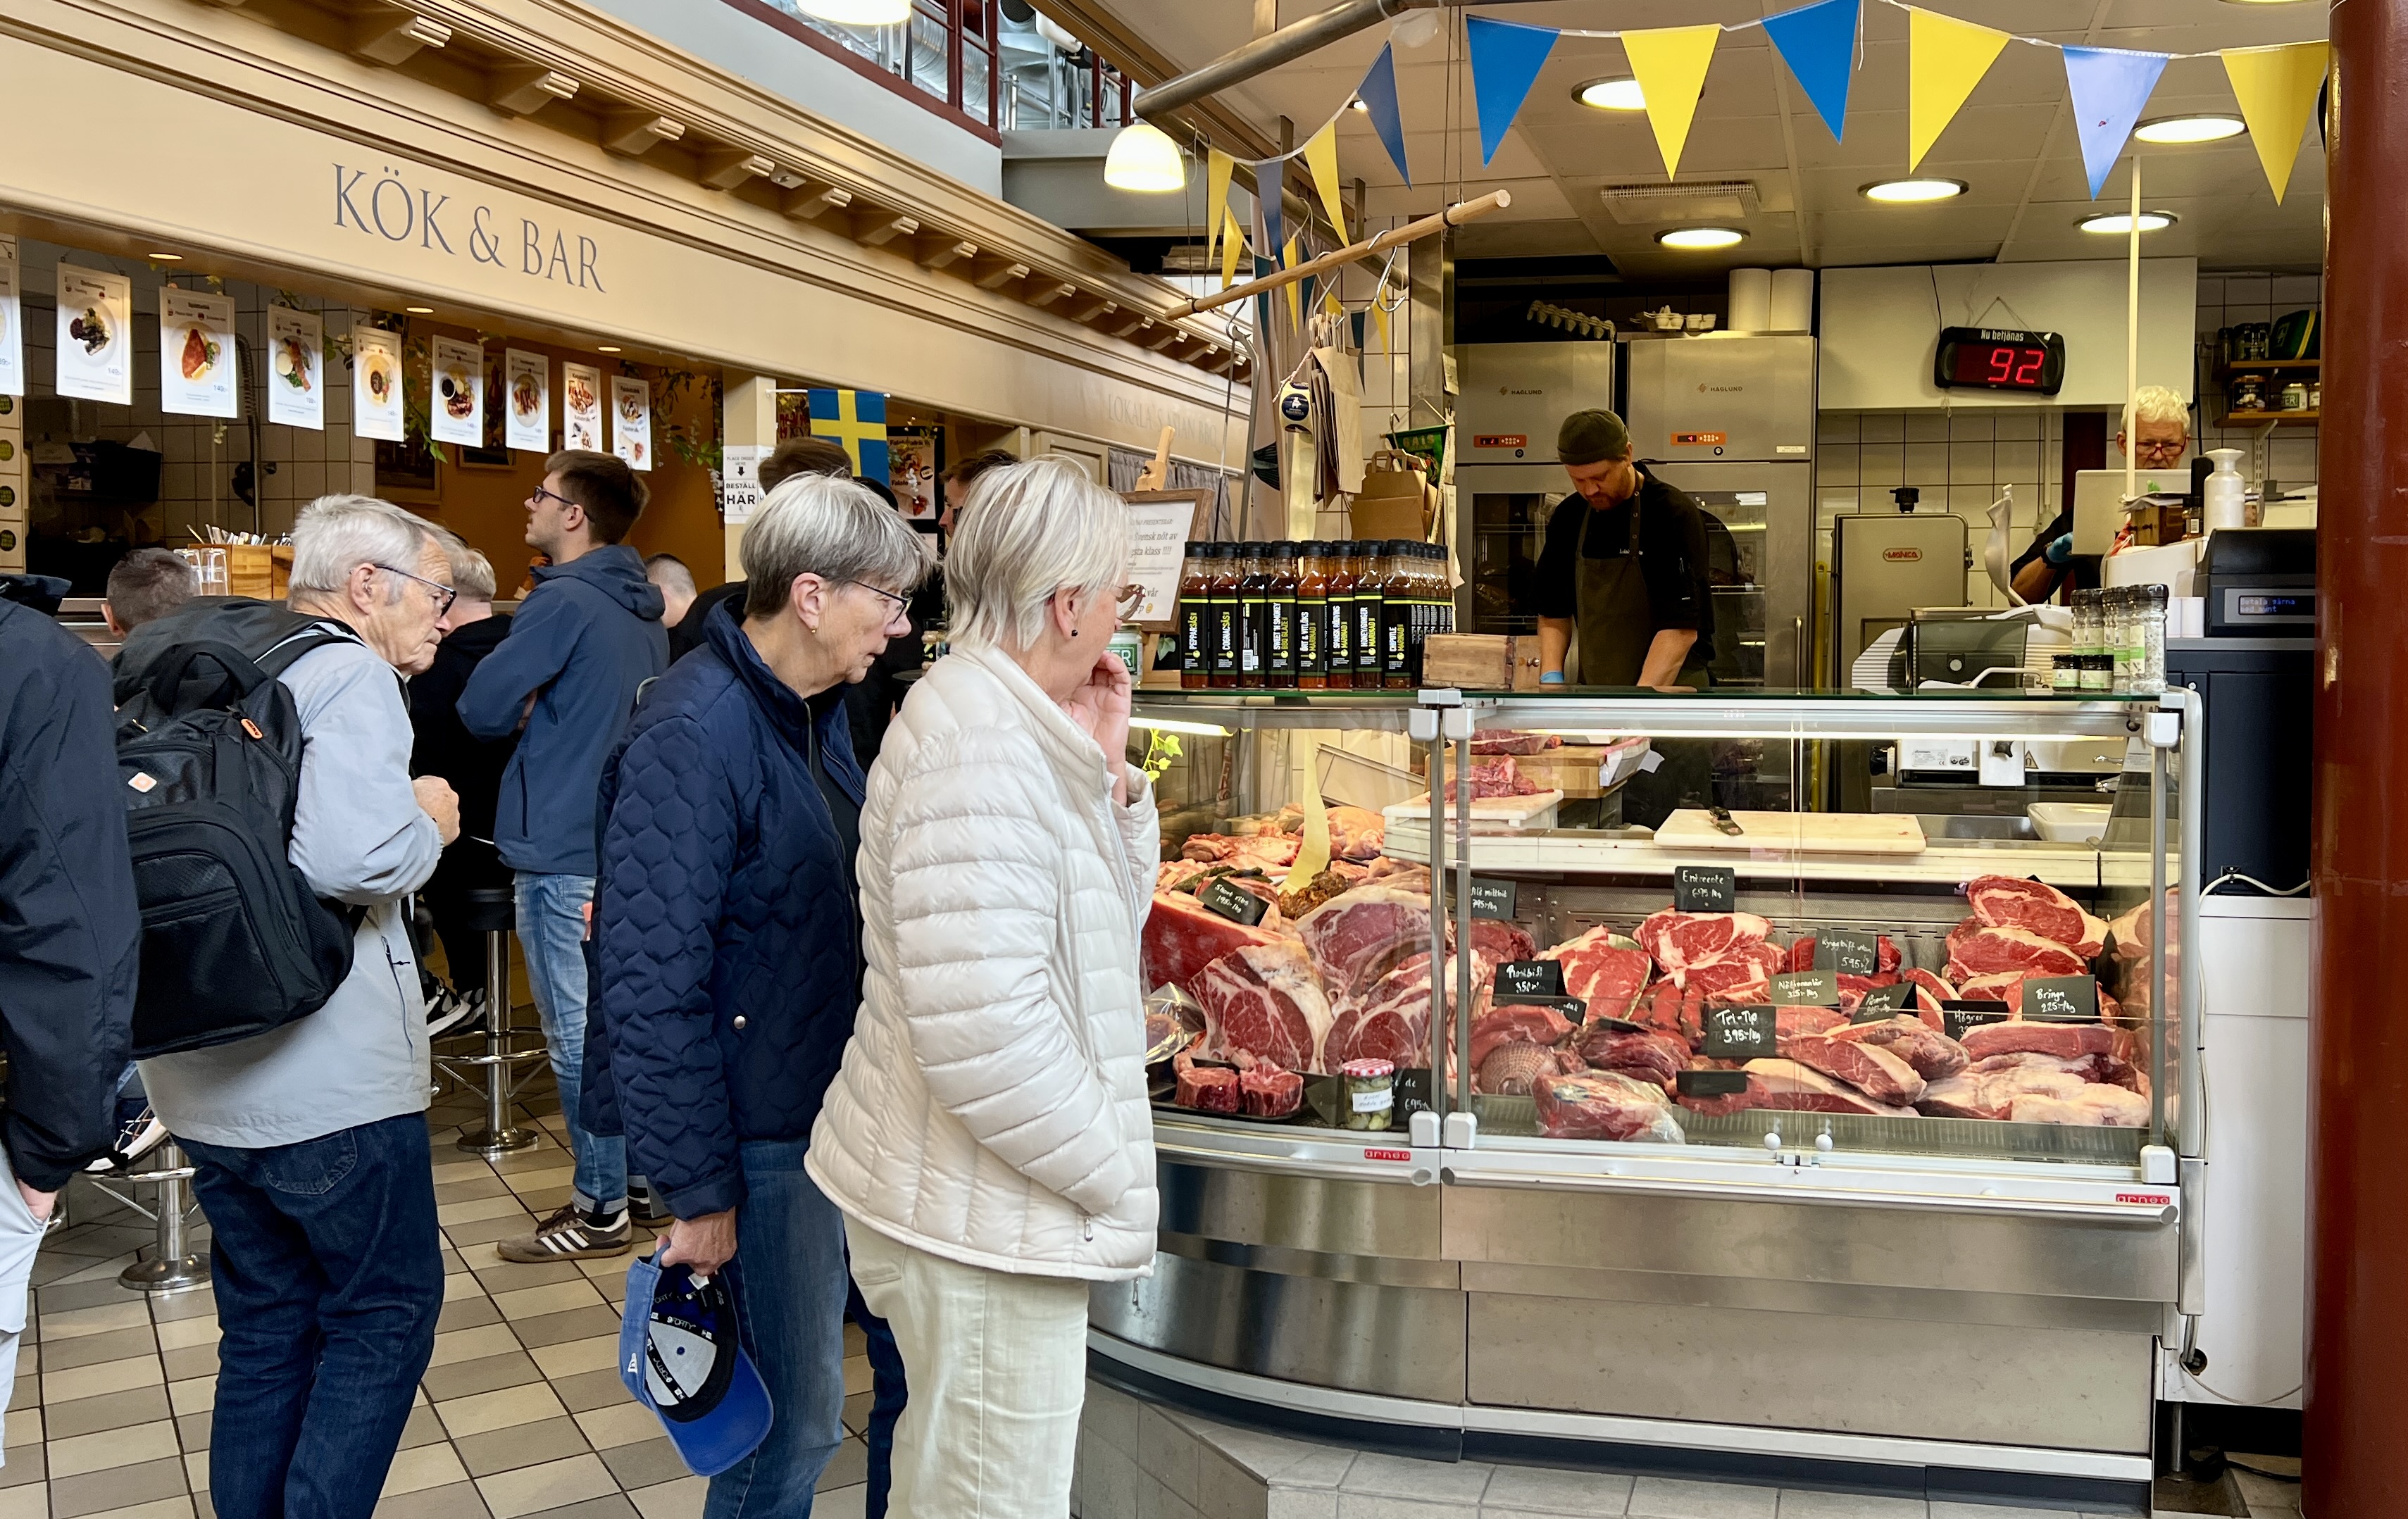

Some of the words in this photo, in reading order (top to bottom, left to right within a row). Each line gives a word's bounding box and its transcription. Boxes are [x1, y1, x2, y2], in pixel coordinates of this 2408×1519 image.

[332, 163, 456, 255] KÖK
[469, 206, 506, 268] &
[520, 218, 606, 293] BAR
[1980, 329, 1990, 340] Nu
[1992, 330, 2024, 342] betjänas
[1988, 348, 2045, 384] 92
[1402, 434, 1435, 449] GAIS
[725, 481, 756, 489] BESTÄLL
[726, 491, 756, 505] HÄR
[1187, 615, 1197, 650] PEPPARSÅS
[1221, 615, 1230, 650] COGNACSÅS
[1273, 632, 1281, 650] SWEET
[2035, 988, 2065, 1002] Bringa
